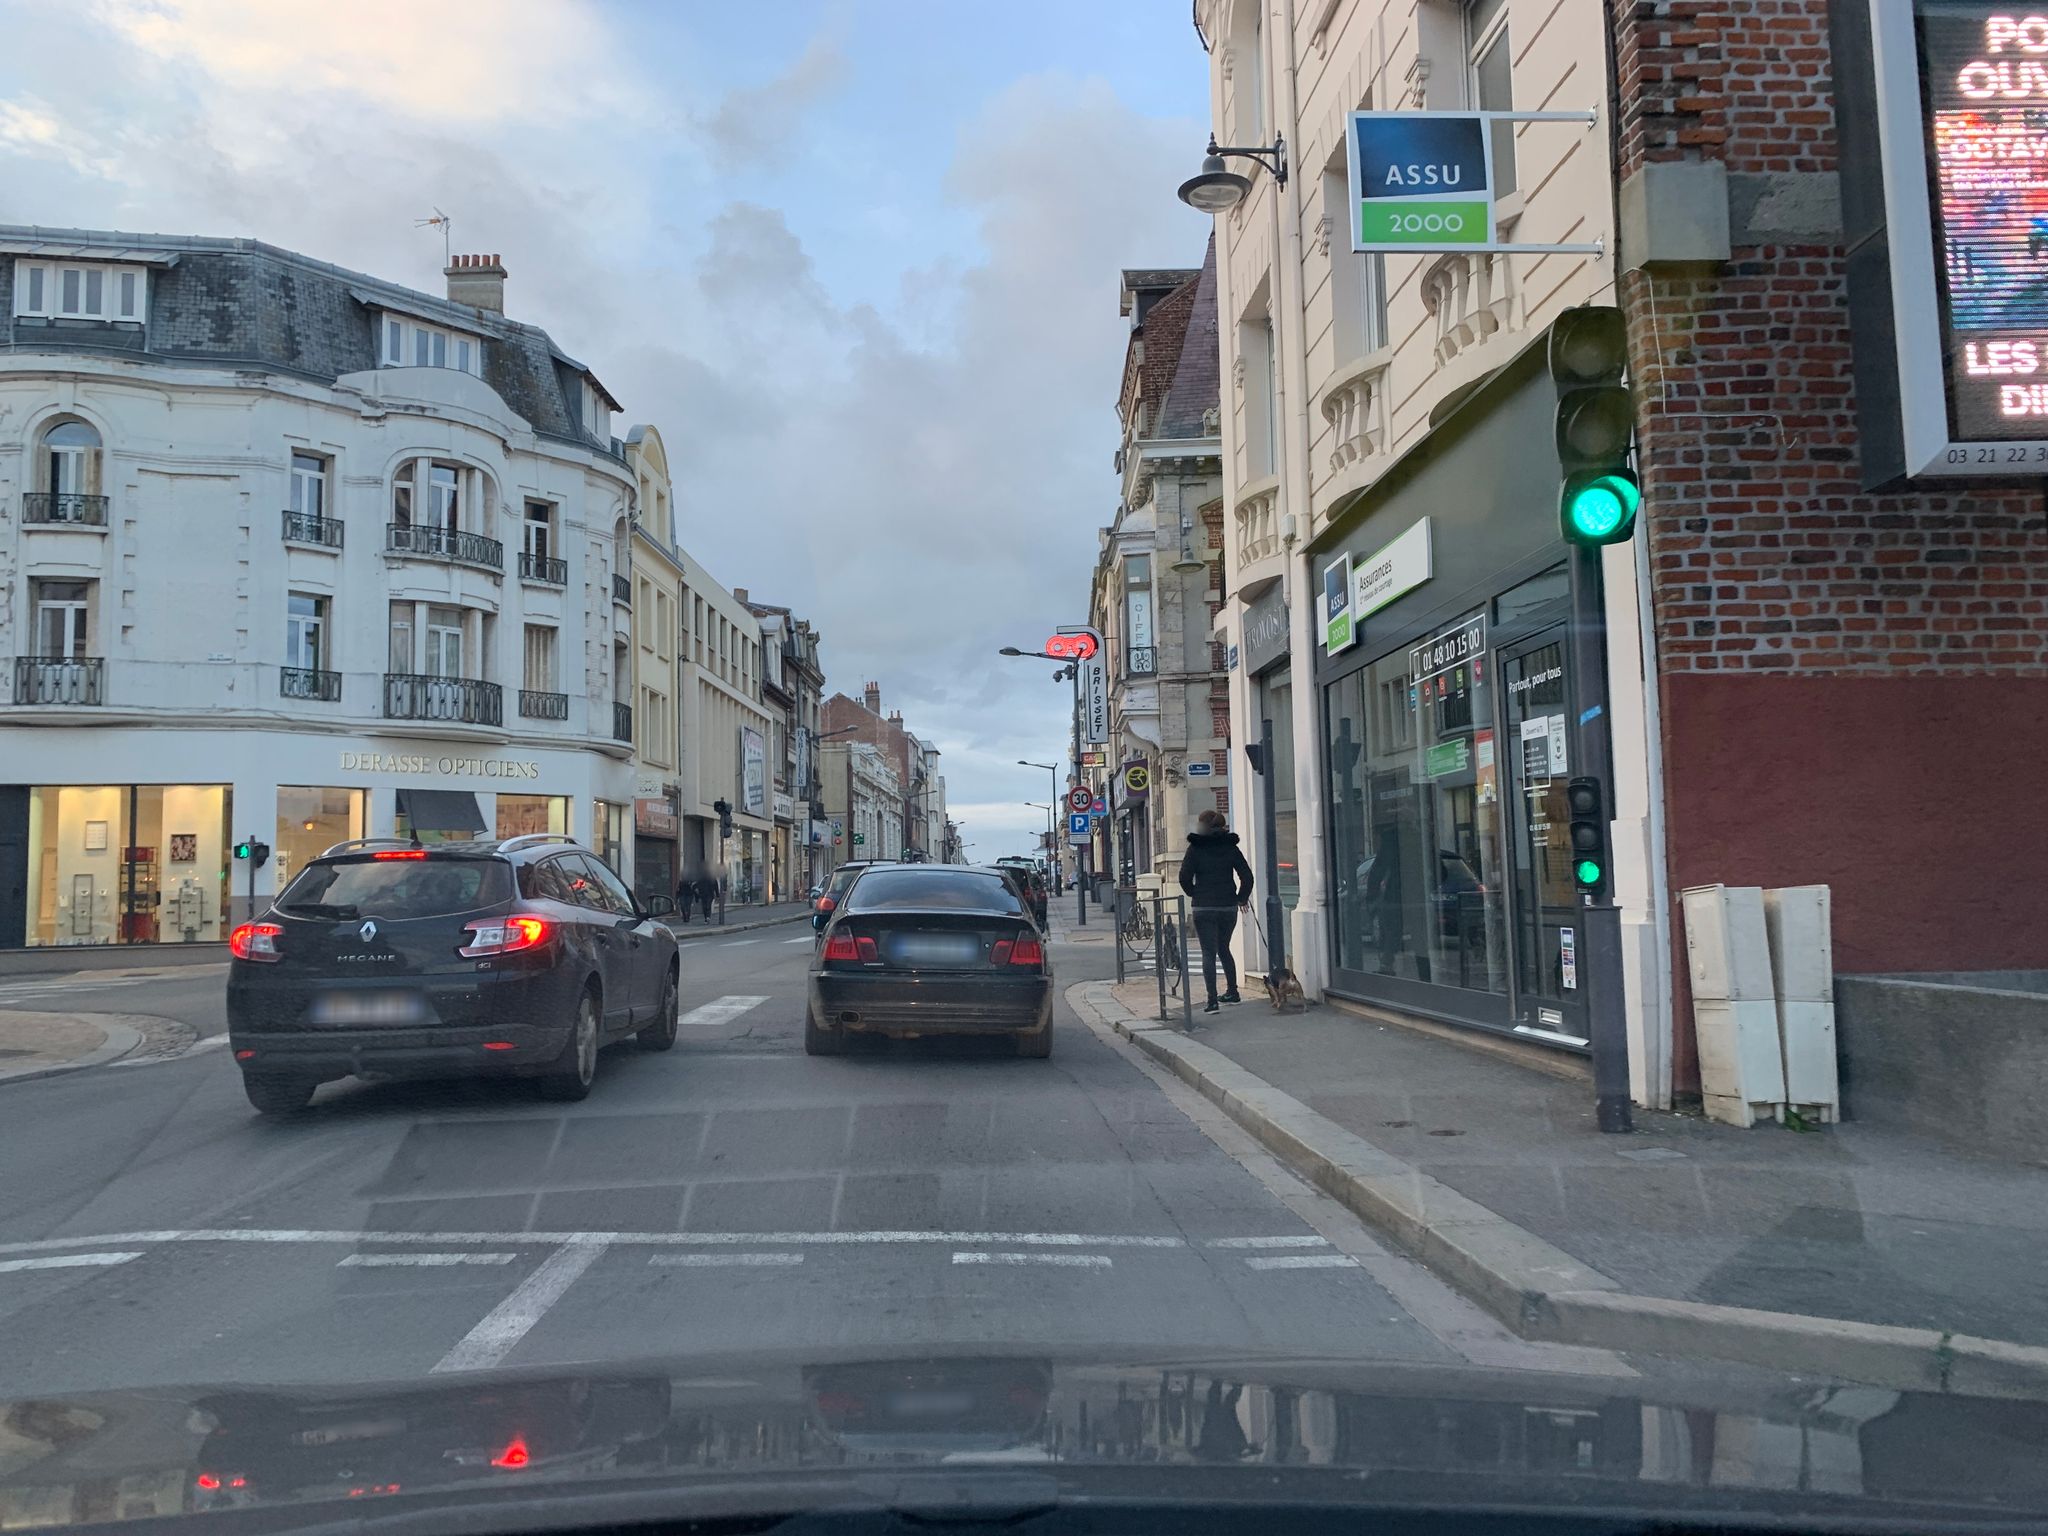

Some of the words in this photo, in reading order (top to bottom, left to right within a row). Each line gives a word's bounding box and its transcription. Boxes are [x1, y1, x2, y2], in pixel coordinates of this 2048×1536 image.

[1385, 164, 1460, 185] ASSU
[1389, 214, 1463, 232] 2000
[1965, 341, 2039, 374] LES
[1947, 449, 1967, 464] 03
[1977, 448, 1996, 463] 21
[2007, 447, 2026, 462] 22
[2037, 447, 2048, 461] 3
[1359, 560, 1393, 593] Assurances
[1330, 591, 1345, 612] ASSU
[1332, 623, 1346, 642] 2000
[1422, 650, 1433, 672] 01
[1433, 646, 1444, 666] 48
[1445, 641, 1455, 662] 10
[1457, 634, 1467, 655] 15
[1468, 627, 1480, 651] 00
[1508, 678, 1532, 694] Partout,
[1532, 673, 1547, 689] pour
[1547, 666, 1562, 681] tous
[1093, 666, 1103, 733] BRISSET
[341, 752, 432, 774] DERASSE
[438, 757, 539, 779] OPTICIENS
[1074, 793, 1089, 806] 30
[1075, 817, 1085, 830] P
[337, 954, 396, 963] MEGANE
